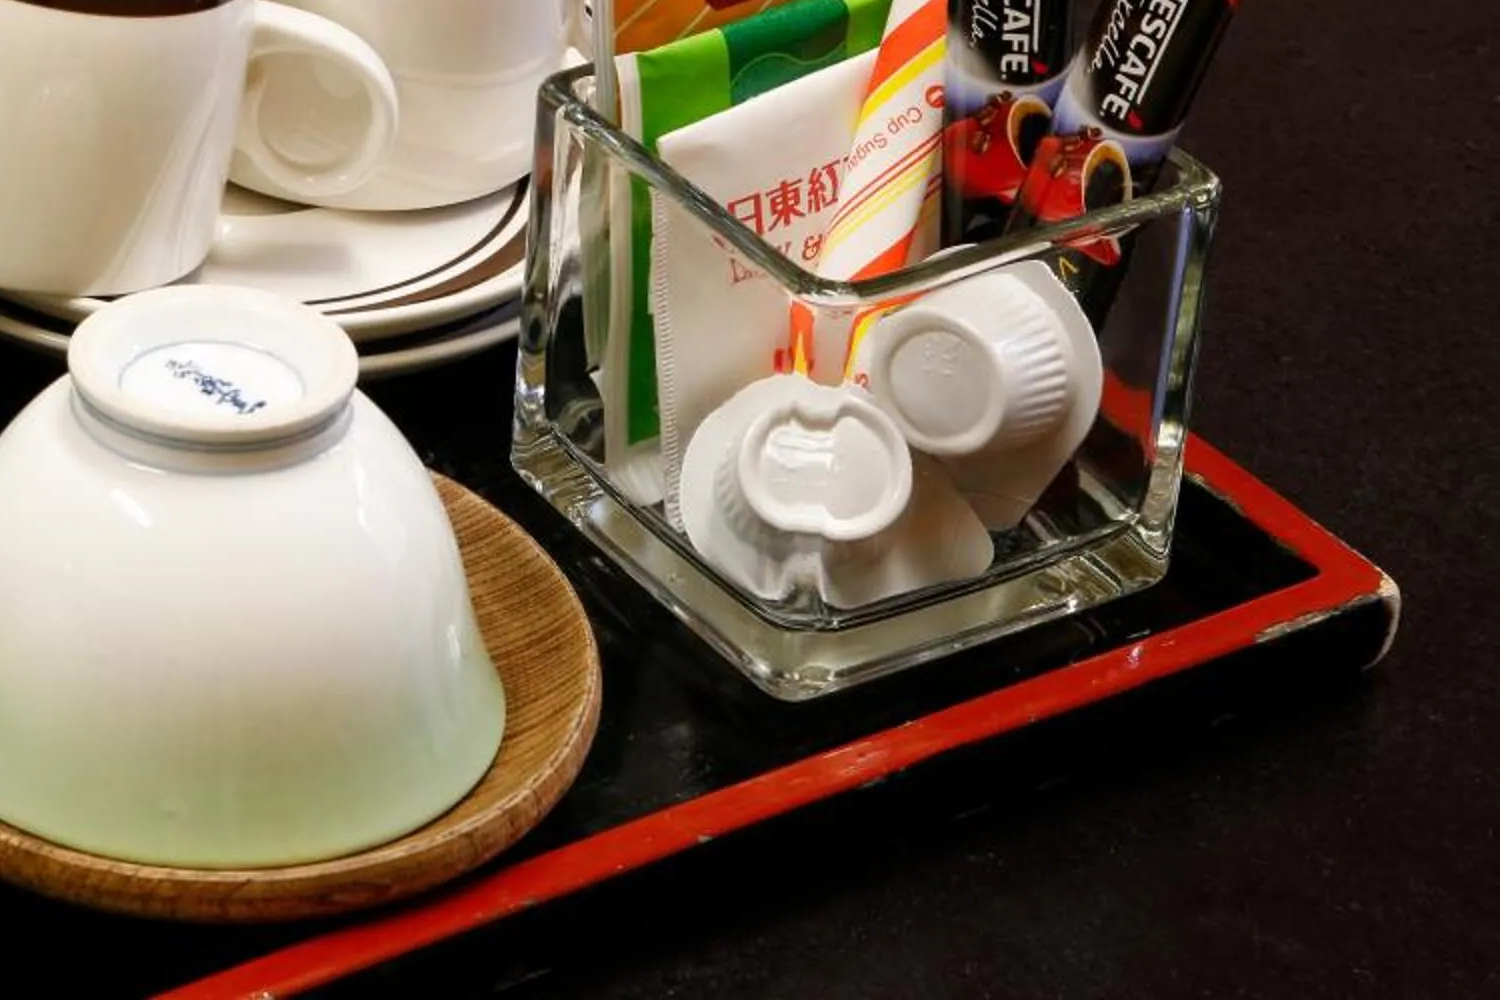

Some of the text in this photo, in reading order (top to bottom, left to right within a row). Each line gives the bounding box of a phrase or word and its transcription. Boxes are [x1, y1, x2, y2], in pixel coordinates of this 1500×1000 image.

[887, 105, 923, 136] Cup
[726, 155, 852, 236] 日東紅
